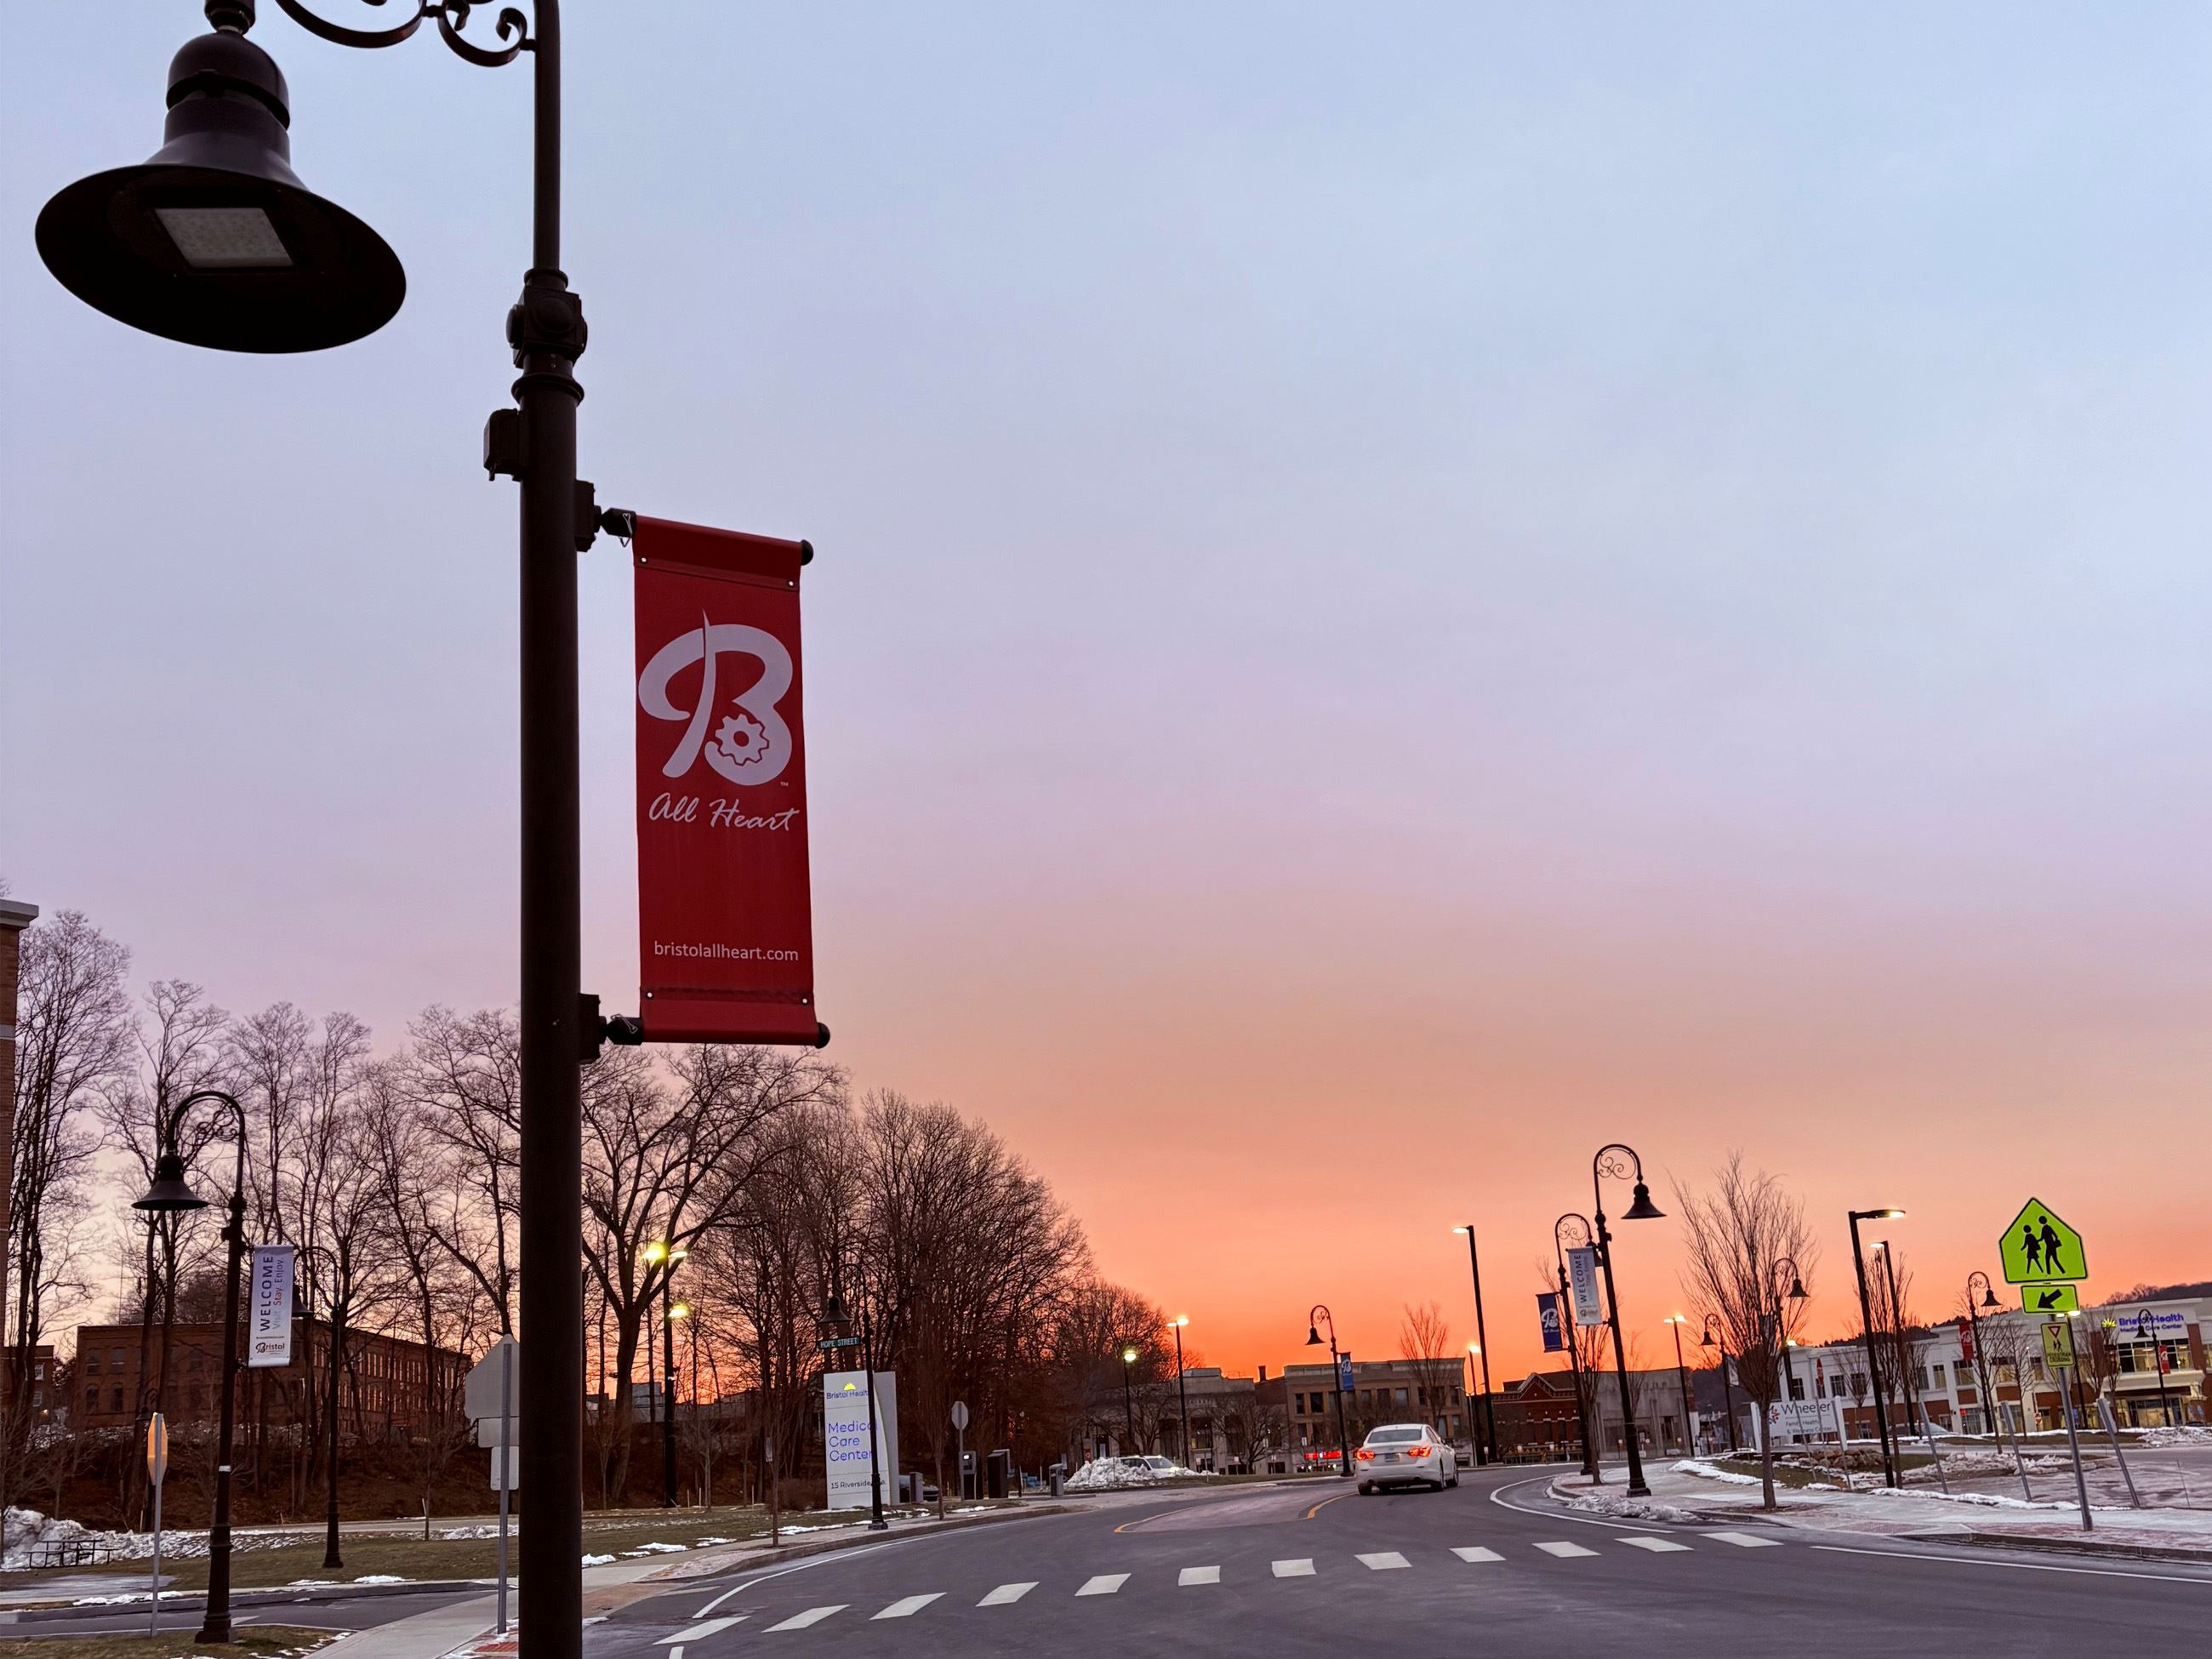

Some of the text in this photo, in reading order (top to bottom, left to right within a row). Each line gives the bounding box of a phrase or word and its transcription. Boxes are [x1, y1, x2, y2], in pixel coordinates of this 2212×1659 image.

[648, 792, 801, 831] All Heart
[654, 940, 799, 961] bristolallheart.com
[1574, 1254, 1588, 1303] WELCOME
[259, 1256, 274, 1332] WELCOME
[820, 1337, 858, 1348] HOPE STREET
[826, 1388, 869, 1400] Bristol Healt
[1781, 1403, 1831, 1415] Wheeer
[829, 1435, 860, 1447] Care
[830, 1450, 872, 1461] Center
[841, 1479, 871, 1488] Riverside
